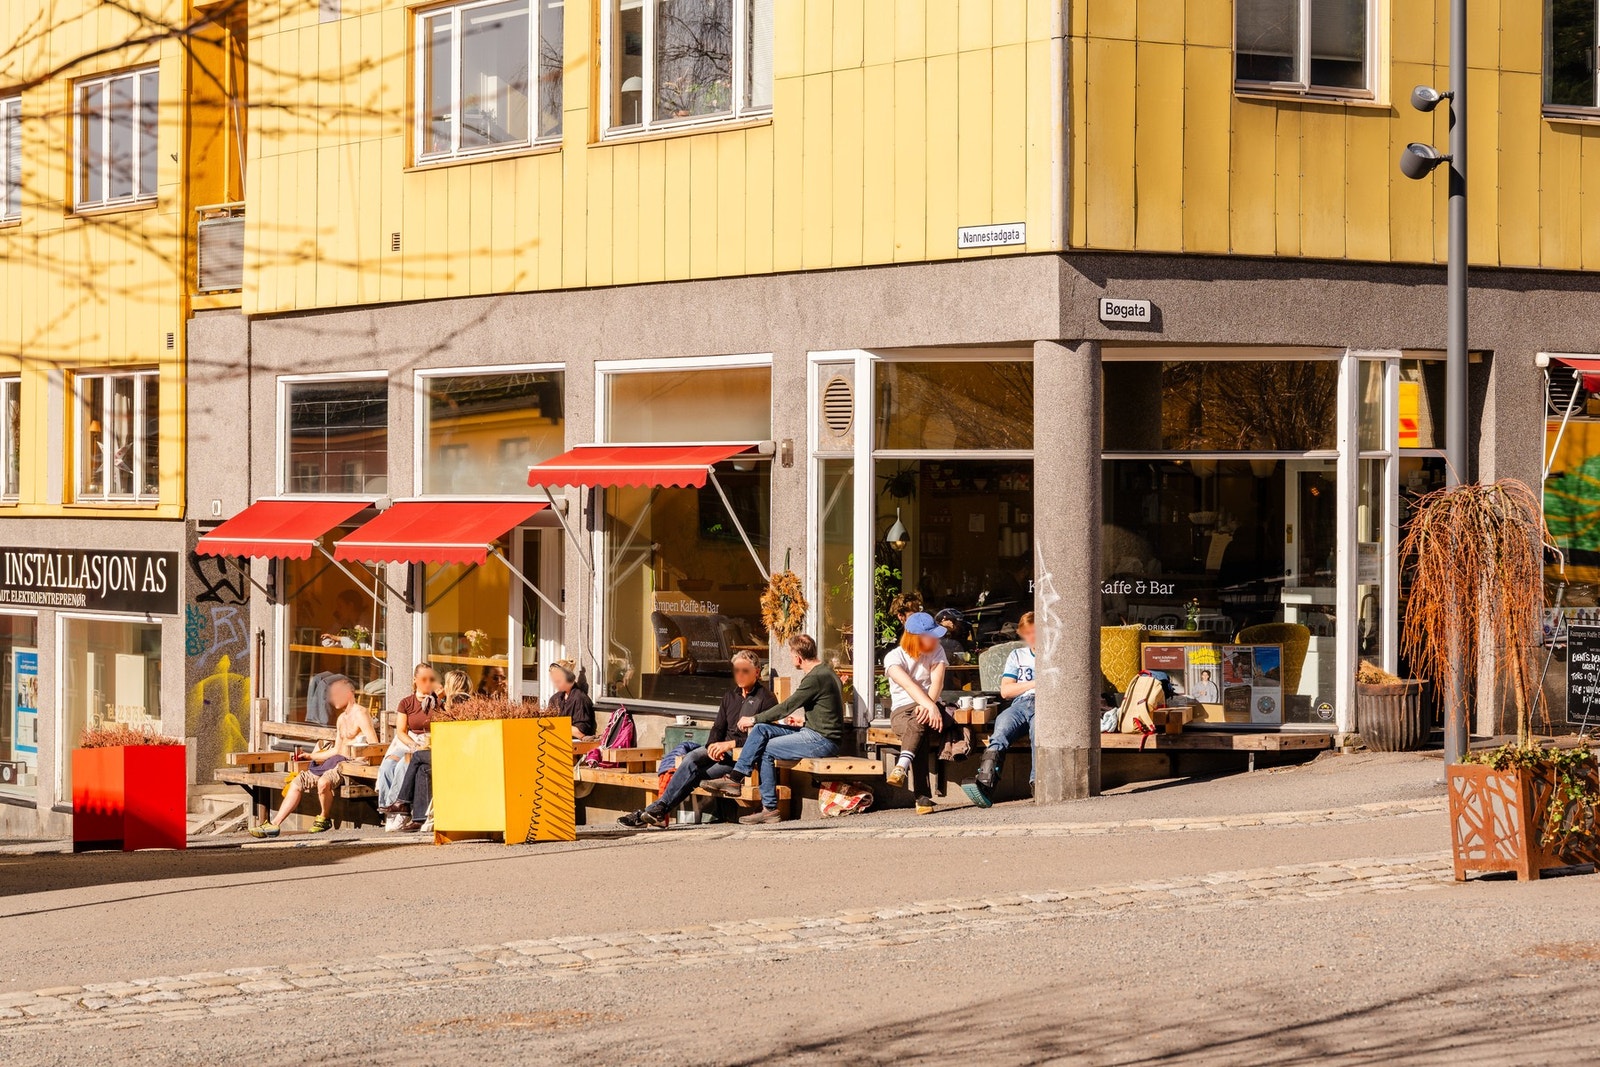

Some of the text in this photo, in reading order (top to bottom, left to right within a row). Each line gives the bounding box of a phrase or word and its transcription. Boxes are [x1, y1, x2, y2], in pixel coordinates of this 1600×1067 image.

[963, 229, 1020, 243] Nannestadgata
[1105, 302, 1146, 318] Bøgata
[4, 552, 137, 599] INSTALLASJON
[141, 557, 167, 593] AS
[1135, 580, 1147, 594] &
[1150, 580, 1175, 594] Bar
[0, 589, 87, 607] UT. ELEKTROENTREPRENØR
[680, 600, 699, 613] Kaffe
[700, 601, 706, 613] &
[707, 601, 720, 614] Bar
[1018, 667, 1033, 681] 23
